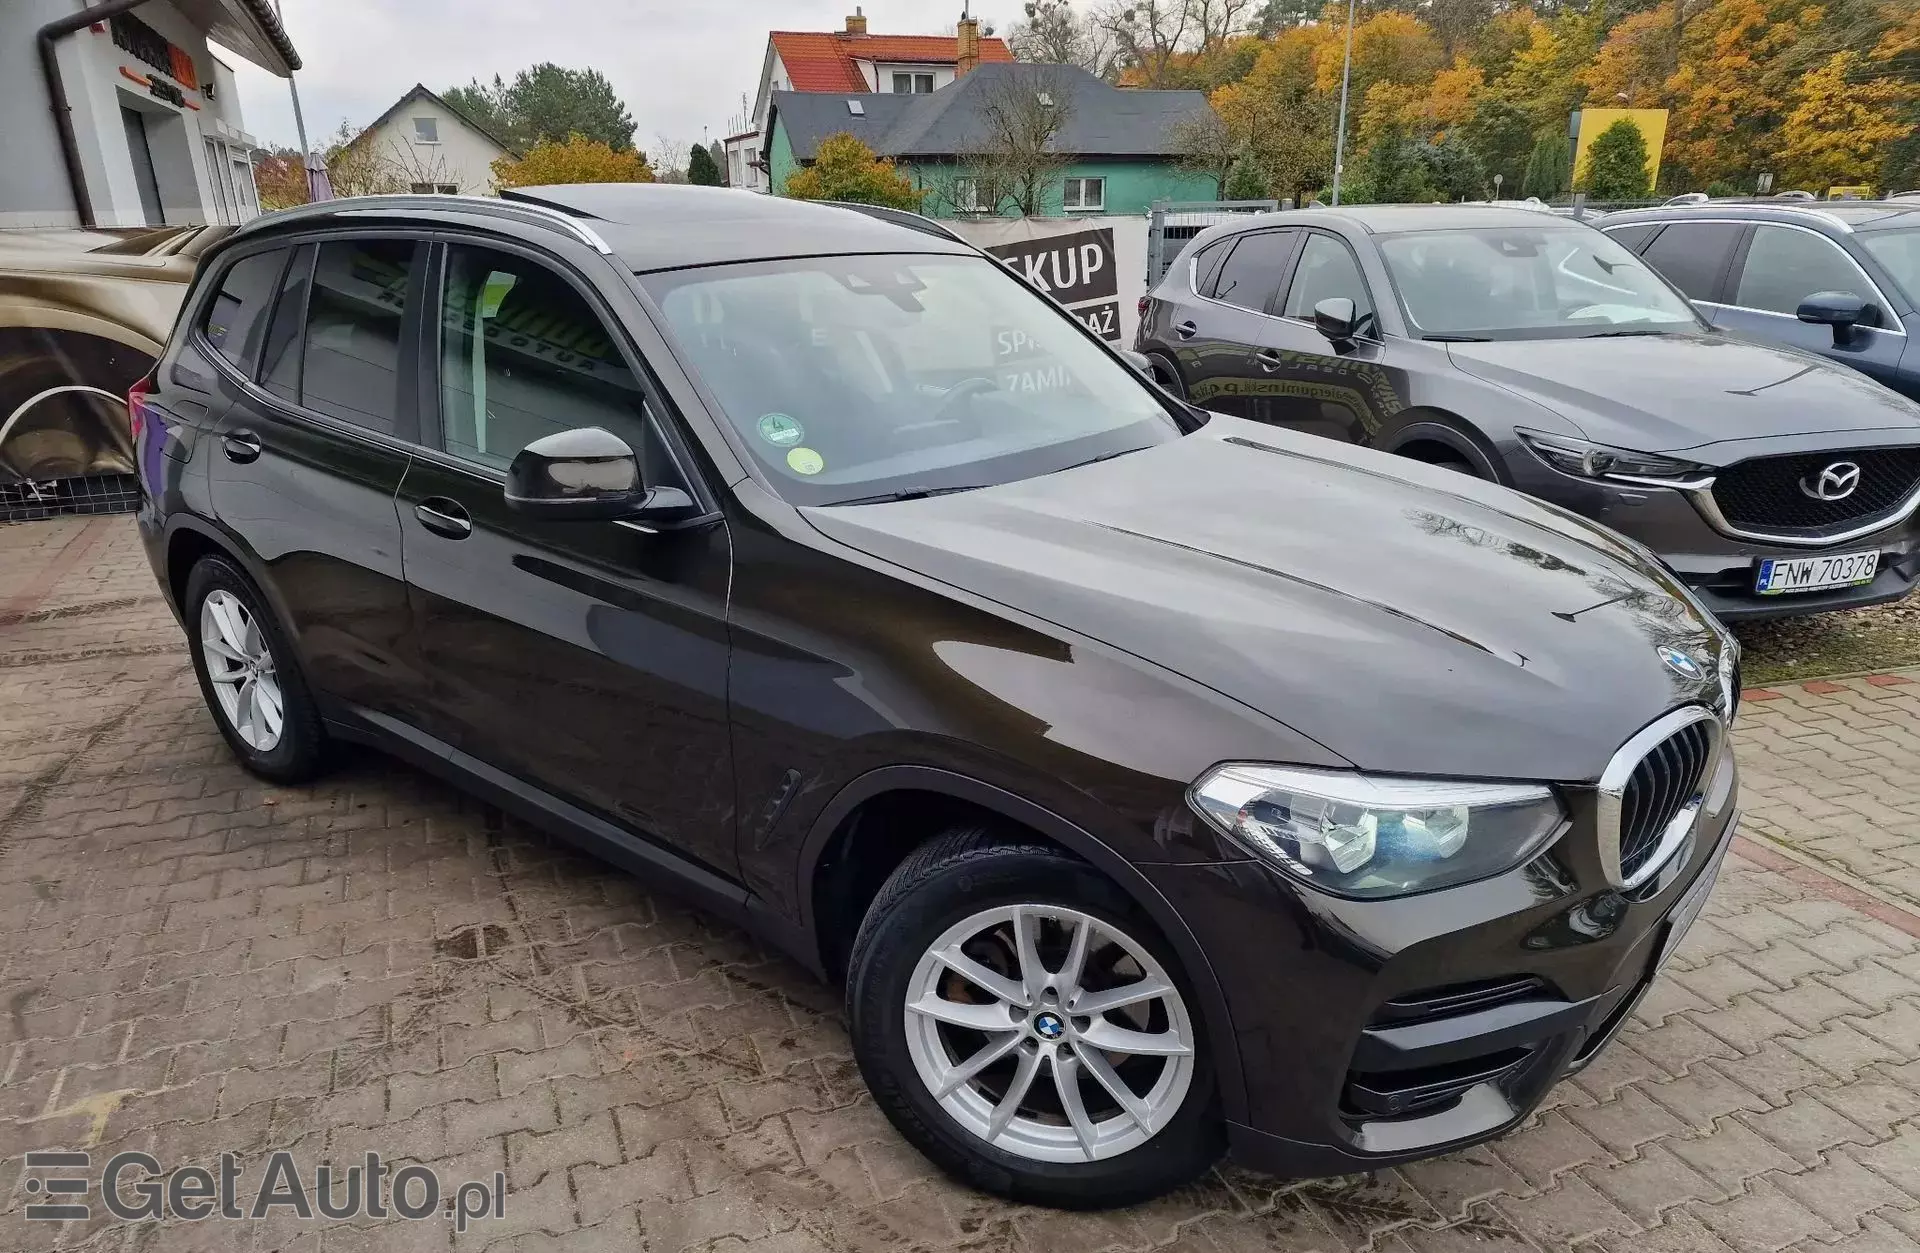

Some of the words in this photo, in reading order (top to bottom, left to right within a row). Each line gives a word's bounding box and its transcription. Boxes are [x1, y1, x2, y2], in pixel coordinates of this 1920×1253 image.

[1001, 243, 1104, 292] KUP
[1770, 561, 1815, 587] FNW
[1819, 554, 1876, 582] 70378
